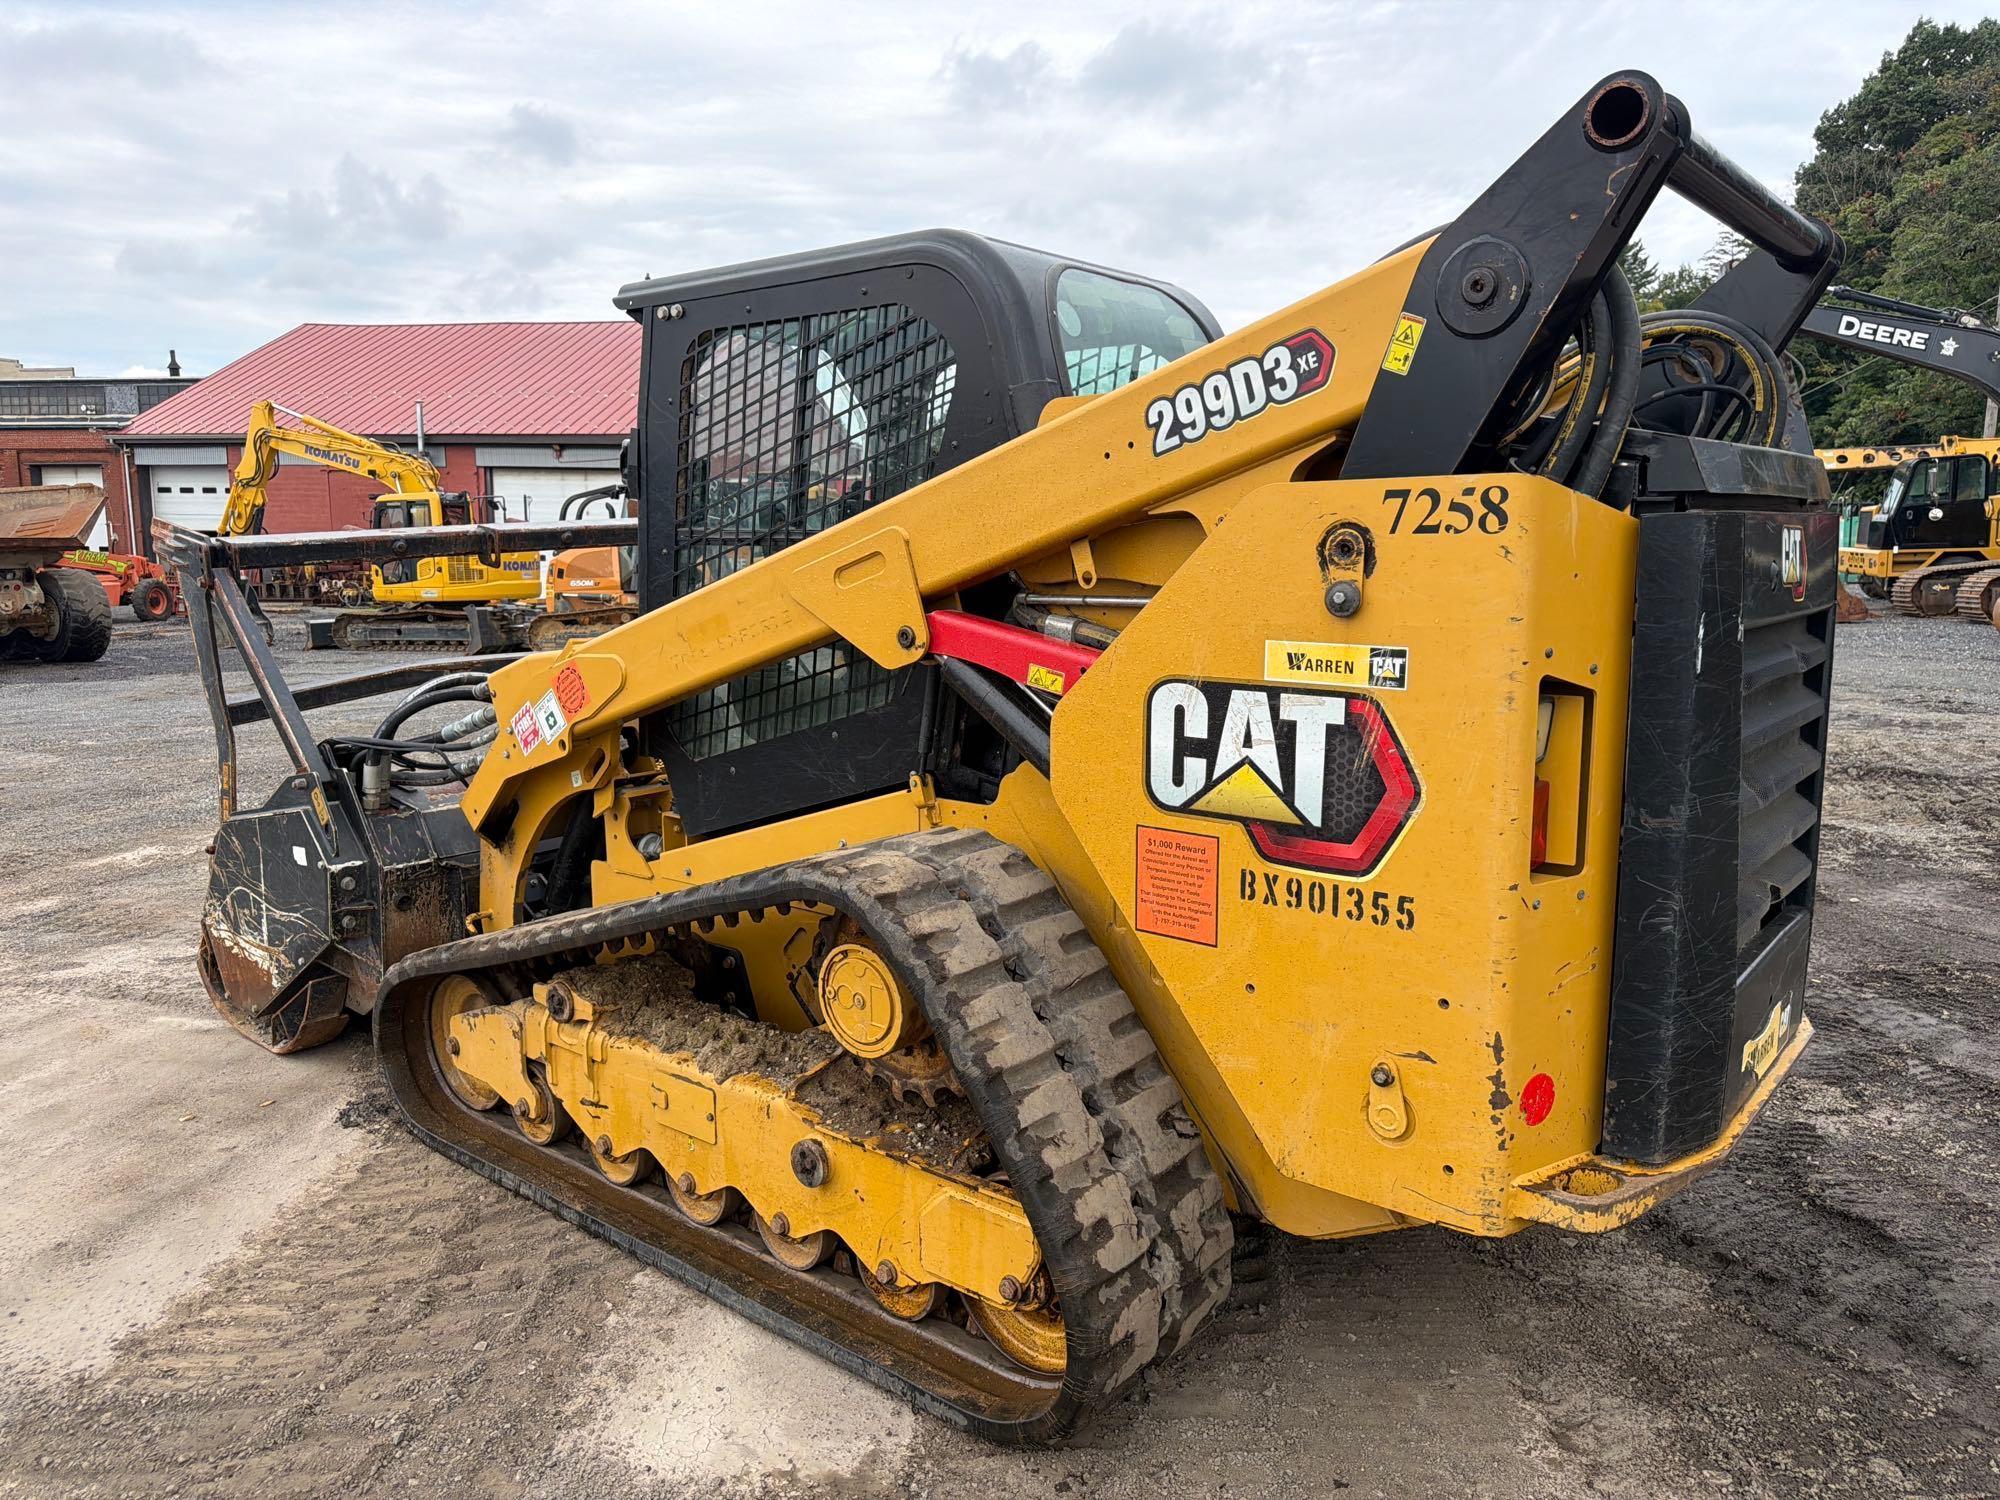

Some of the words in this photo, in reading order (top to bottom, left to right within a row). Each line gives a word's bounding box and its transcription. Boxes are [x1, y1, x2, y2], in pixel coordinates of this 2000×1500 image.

[1838, 314, 1930, 350] DEERE
[1148, 345, 1299, 454] 299D3
[1296, 351, 1319, 374] XE
[304, 444, 360, 469] KOMATSU
[1382, 485, 1509, 535] 7258
[1782, 527, 1801, 583] CAT
[570, 579, 594, 587] 650M
[1286, 652, 1354, 674] WARREN
[1371, 656, 1406, 679] CAT
[1151, 682, 1346, 828] CAT
[1147, 838, 1173, 850] $1,000
[1175, 842, 1206, 855] Reward
